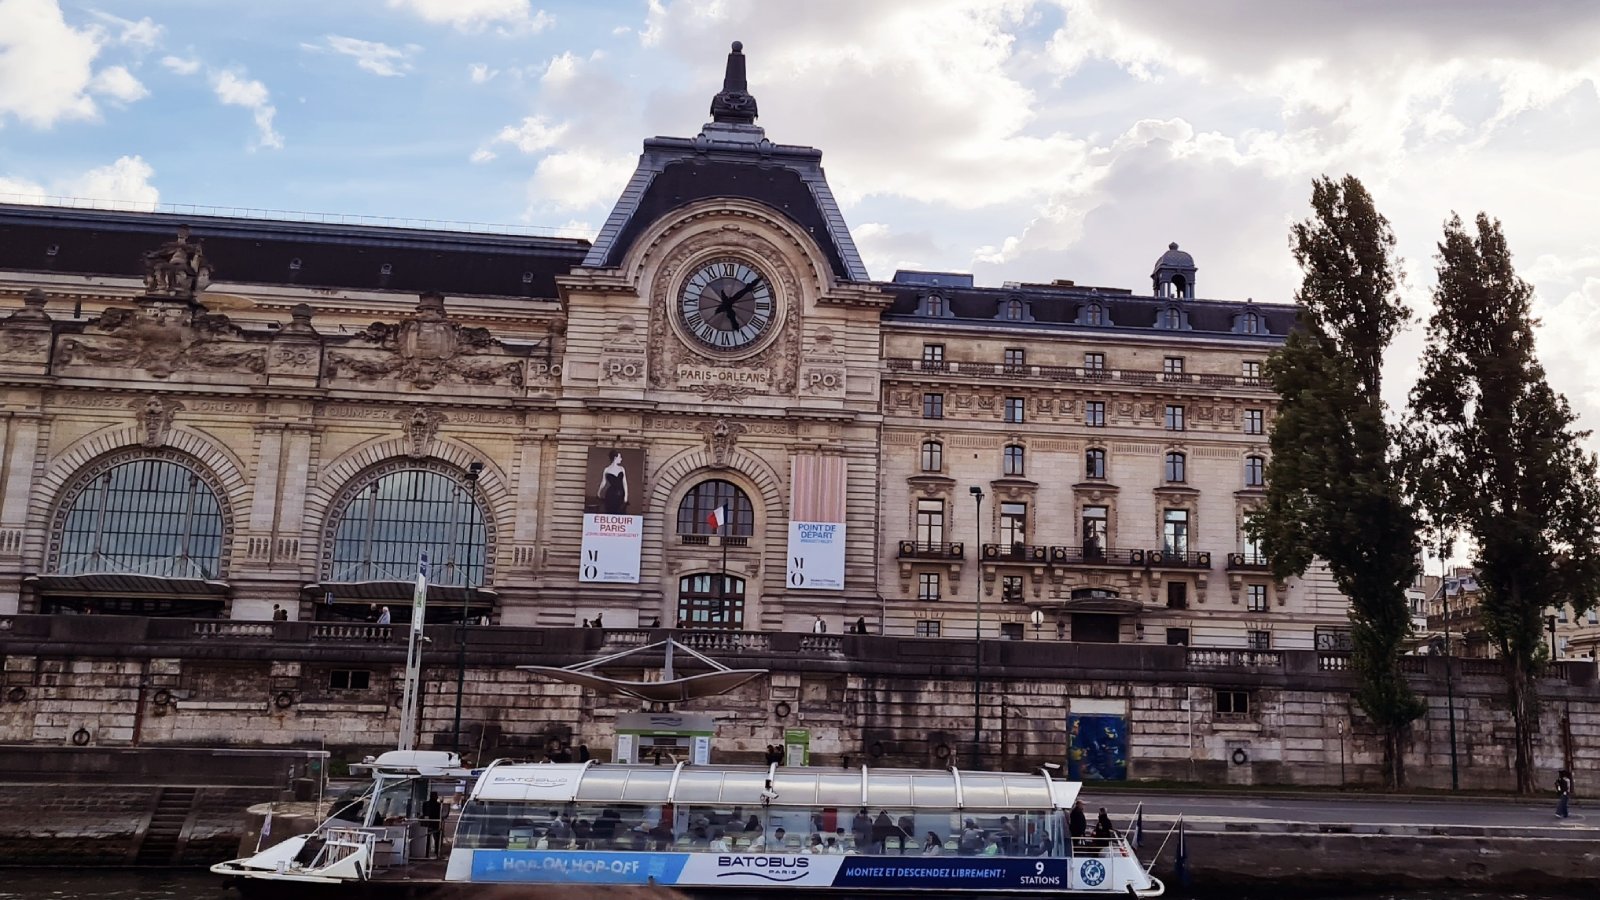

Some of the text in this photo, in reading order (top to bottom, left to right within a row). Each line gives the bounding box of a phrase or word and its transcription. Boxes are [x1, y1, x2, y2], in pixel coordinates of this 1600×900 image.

[704, 266, 717, 280] XI
[722, 263, 735, 277] XII
[690, 279, 704, 291] X
[755, 302, 770, 311] III
[536, 363, 562, 377] PO
[609, 363, 637, 377] PO
[680, 369, 766, 383] PARIS-ORLEANS
[810, 373, 837, 387] PO
[191, 400, 252, 413] LORIENT
[328, 405, 391, 419] QUIMPER
[451, 412, 516, 425] AURILLAC
[747, 422, 788, 435] TOURS
[600, 524, 626, 532] PARIS
[798, 523, 824, 531] POINT
[801, 530, 834, 539] DÉPART
[573, 859, 640, 874] HOP-OFF
[718, 856, 809, 868] BATOBUS
[1035, 861, 1045, 875] 9
[846, 867, 883, 877] MONTEZ
[885, 867, 897, 877] ET
[897, 868, 950, 877] DESCENDEZ
[1020, 876, 1060, 885] STATIONS
